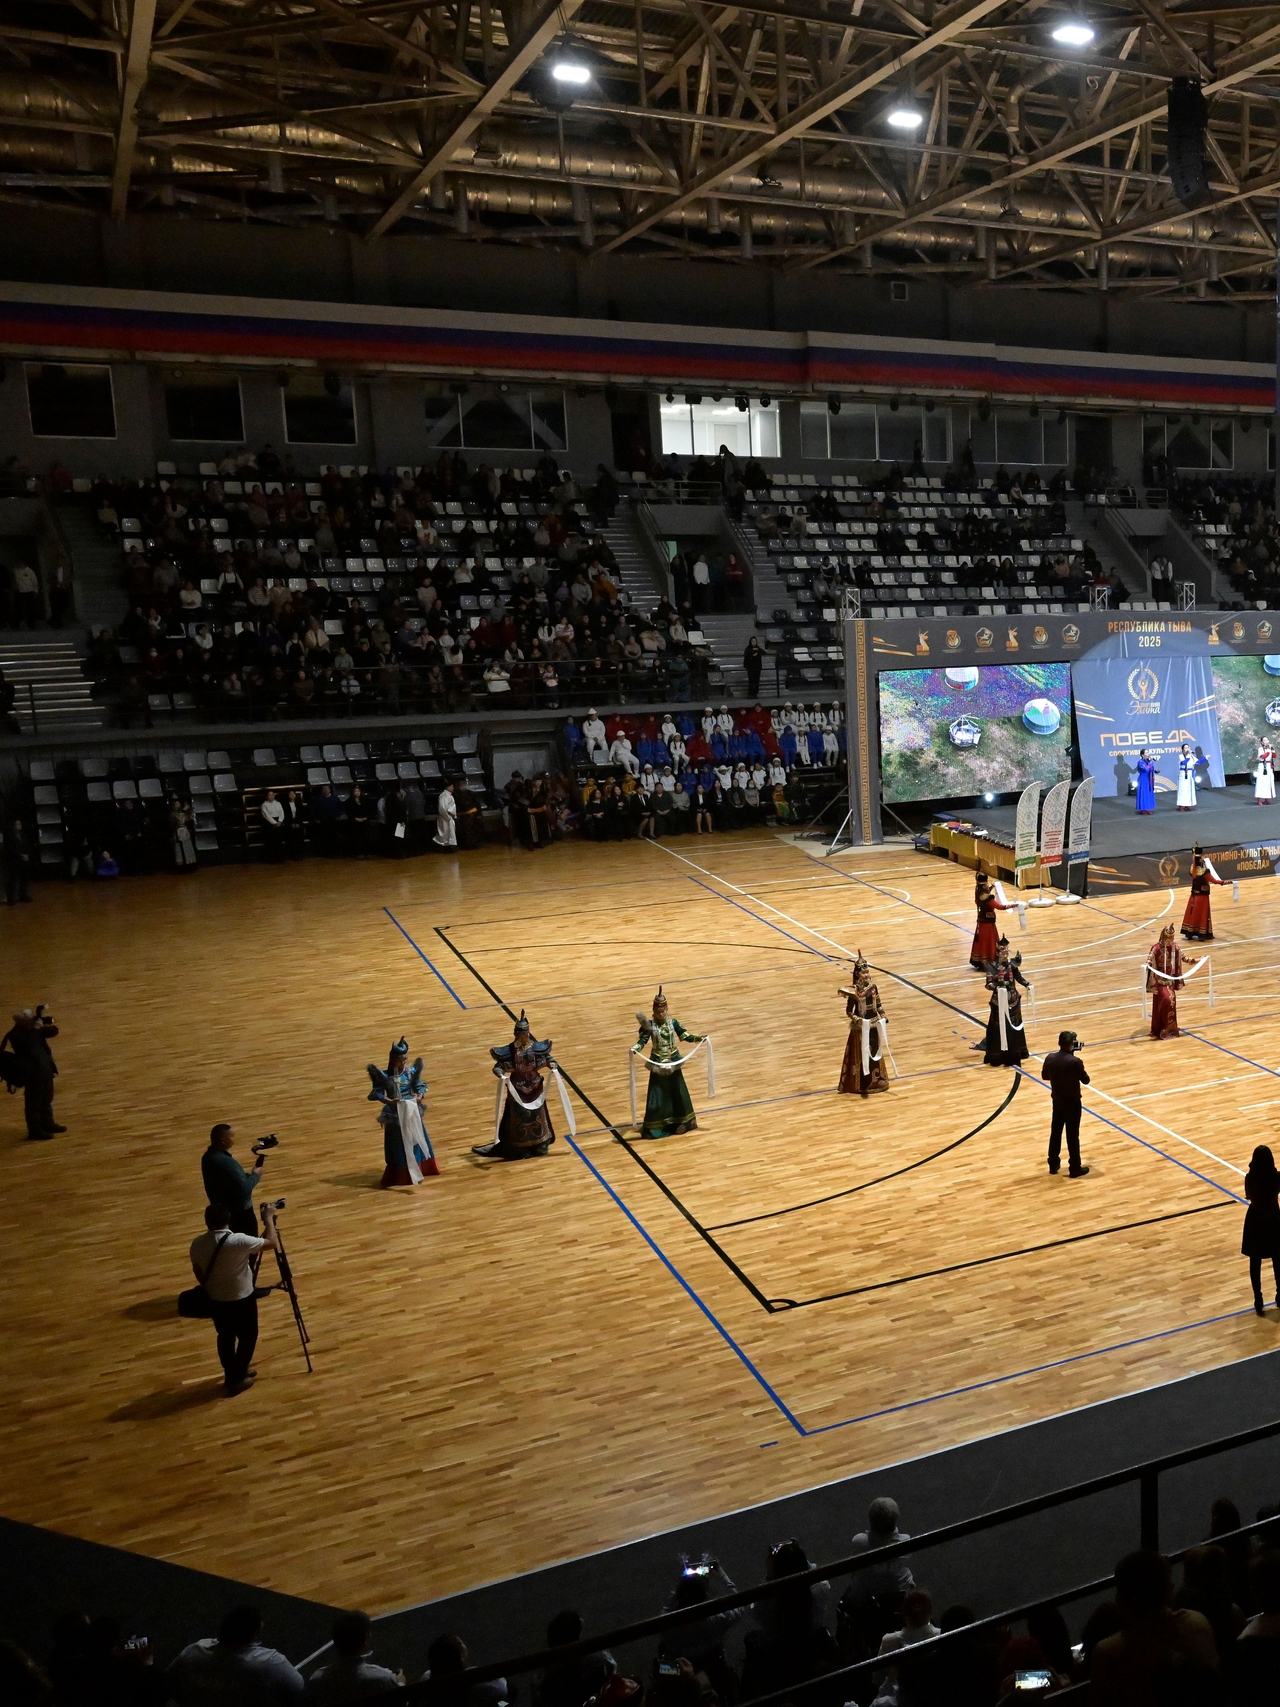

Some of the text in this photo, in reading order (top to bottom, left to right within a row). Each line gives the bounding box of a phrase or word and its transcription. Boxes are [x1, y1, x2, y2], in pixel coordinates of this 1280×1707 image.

[1108, 620, 1192, 633] РЕСПУБЛИКА ТЫВА
[1138, 635, 1161, 647] 2025
[1237, 859, 1270, 871] «ПОБЕДА»
